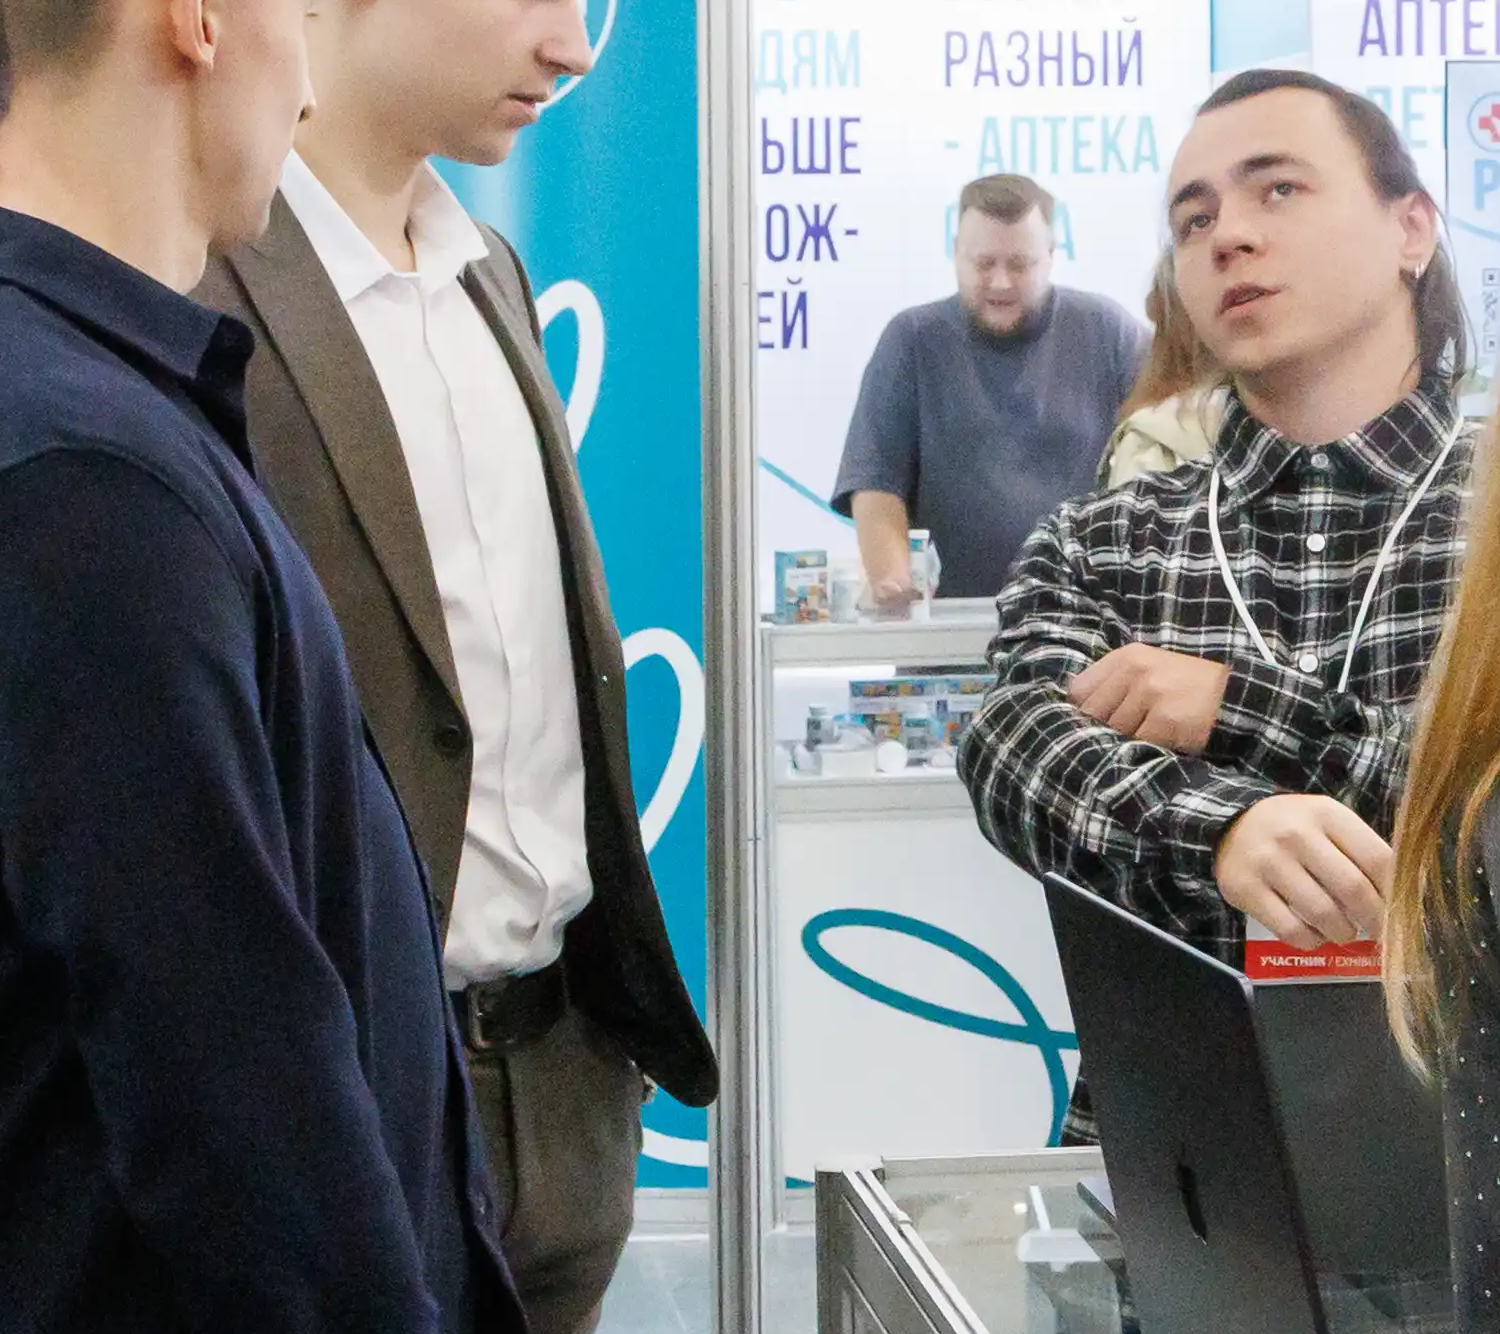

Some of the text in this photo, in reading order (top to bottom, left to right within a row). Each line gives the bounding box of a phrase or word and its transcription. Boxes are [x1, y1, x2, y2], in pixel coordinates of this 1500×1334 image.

[754, 28, 862, 96] ДЯМ
[944, 17, 1143, 88] РАЗНЫЙ
[760, 116, 862, 175] ЬШЕ
[976, 114, 1161, 175] АПТЕКА
[764, 203, 859, 263] ОЖ-
[757, 276, 809, 349] ЕЙ
[1259, 955, 1326, 967] УЧАСТНИК
[1336, 955, 1384, 967] EXHIBITO
